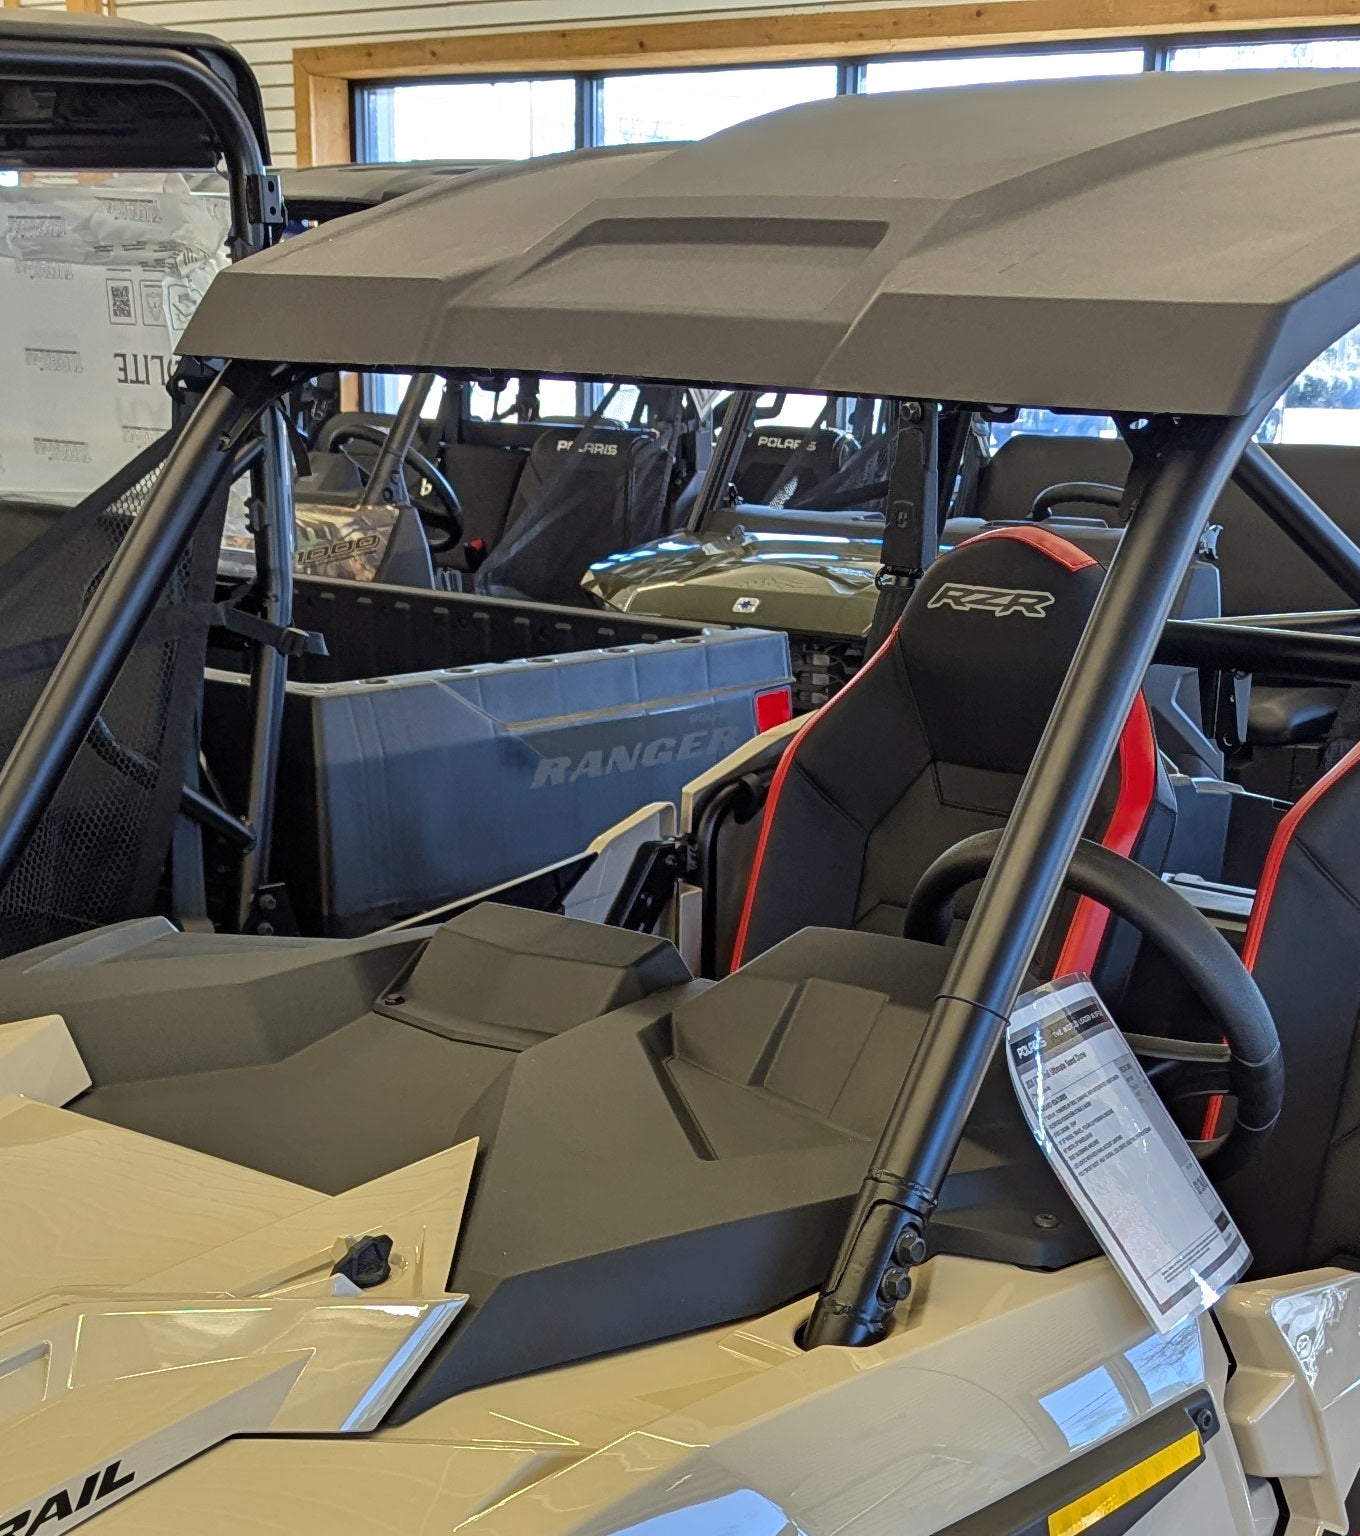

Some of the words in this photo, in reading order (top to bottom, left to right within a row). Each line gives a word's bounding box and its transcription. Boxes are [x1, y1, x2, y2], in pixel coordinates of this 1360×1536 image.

[757, 435, 817, 452] POLARS
[297, 534, 381, 564] 1000
[927, 582, 1055, 617] RZR
[530, 726, 739, 790] RANGER
